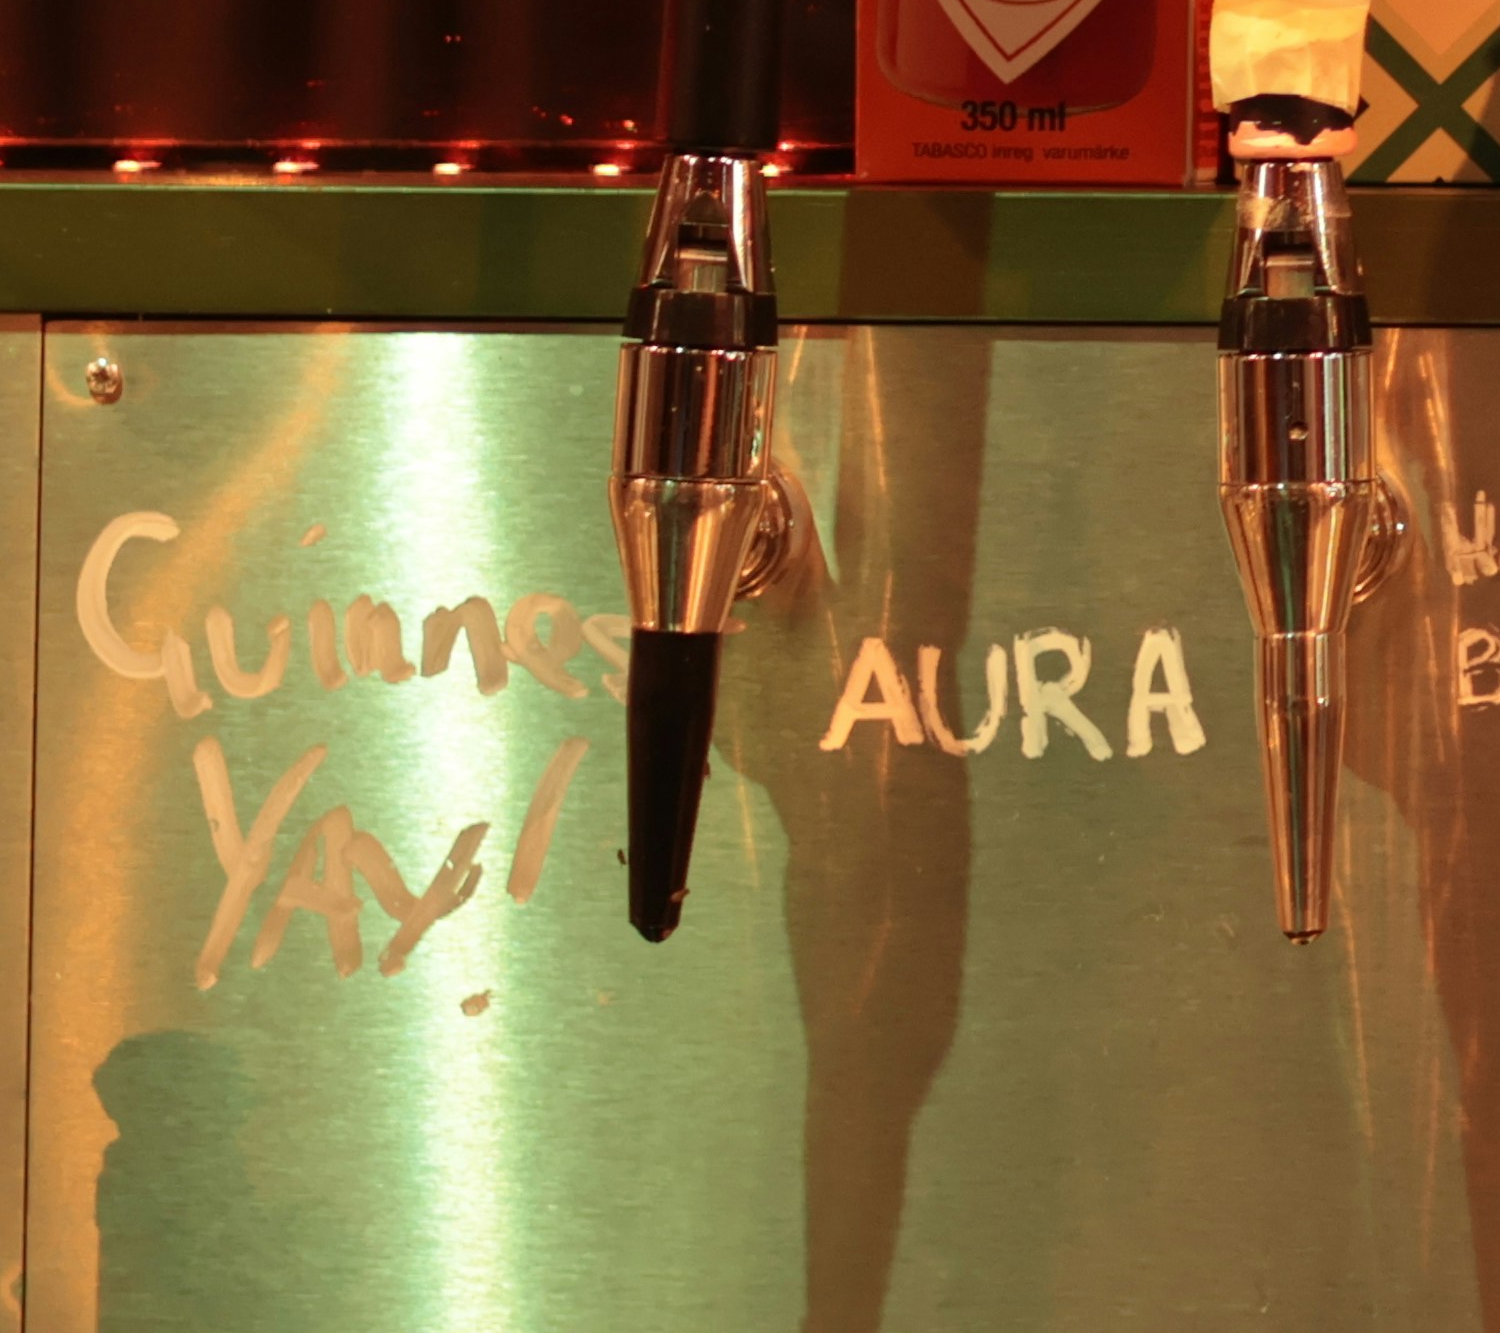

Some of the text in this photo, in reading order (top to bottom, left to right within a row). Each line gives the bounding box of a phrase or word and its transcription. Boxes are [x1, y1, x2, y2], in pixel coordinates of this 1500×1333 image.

[911, 141, 987, 159] TABASCO
[961, 100, 1067, 132] 350 ml
[77, 511, 632, 718] Guinnes
[818, 628, 1206, 761] AURA
